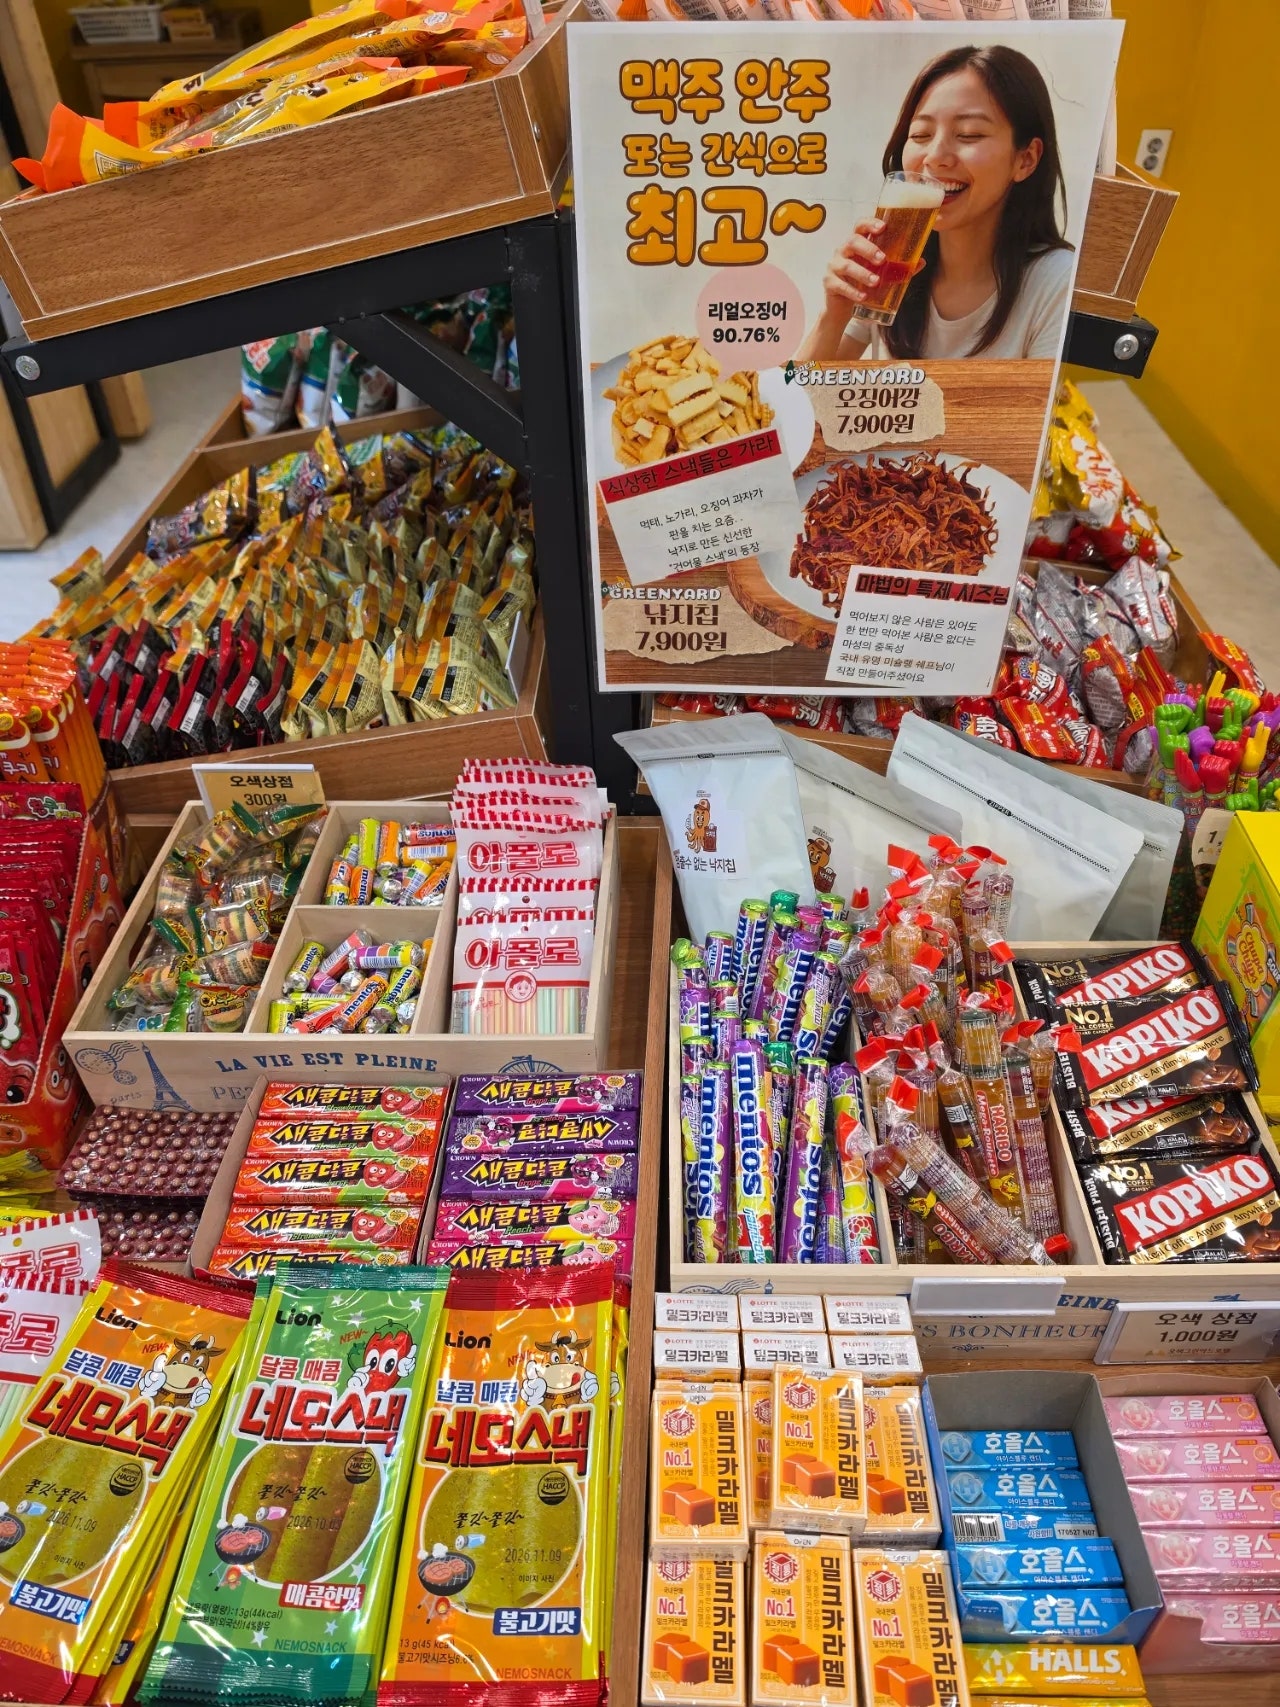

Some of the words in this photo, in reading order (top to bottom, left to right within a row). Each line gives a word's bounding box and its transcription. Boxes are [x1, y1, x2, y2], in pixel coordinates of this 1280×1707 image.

[620, 57, 724, 125] 맥주
[734, 57, 832, 124] 안주
[621, 132, 692, 179] 또는
[700, 131, 828, 176] 간식으로
[708, 301, 787, 321] 리얼오징어
[712, 327, 780, 343] 90.76%
[794, 368, 926, 386] GREENYARD
[836, 388, 922, 408] 오징어깡
[837, 413, 914, 435] 7,900원
[607, 469, 657, 497] 식상한
[665, 448, 733, 482] 스낵들은
[739, 435, 774, 456] 가라
[666, 507, 698, 523] 노가리,
[700, 497, 731, 514] 오징어
[733, 488, 763, 503] 과자가
[669, 529, 689, 540] 판을
[692, 522, 711, 534] 치는
[668, 542, 698, 557] 낙지로
[700, 535, 719, 550] 만든
[723, 527, 752, 543] 신선한
[741, 542, 760, 556] 등장
[609, 588, 721, 600] GREENYARD
[855, 573, 910, 596] 마법의
[916, 579, 954, 600] 특제
[850, 610, 889, 623] 먹어보지
[892, 615, 911, 625] 않은
[914, 618, 944, 628] 사람은
[948, 619, 977, 632] 있어도
[635, 632, 727, 652] 7,900원
[846, 625, 855, 635] 한
[859, 626, 878, 637] 번만
[881, 628, 911, 640] 먹어본
[914, 632, 944, 643] 사람은
[947, 635, 976, 646] 없다는
[842, 640, 872, 650] 마성의
[875, 643, 904, 654] 중독성
[840, 653, 858, 663] 국내
[862, 655, 881, 665] 유명
[836, 666, 855, 677] 직접
[858, 669, 925, 682] 만들어주셨어요
[229, 773, 294, 790] 오색상점
[468, 841, 580, 873] 아폴로
[694, 857, 707, 871] 없는
[300, 947, 318, 973] mentos
[465, 937, 581, 970] 아폴로
[1238, 939, 1257, 984] Chups
[1245, 931, 1264, 975] Chupa
[1043, 960, 1088, 980] No.1
[344, 981, 378, 1016] mentos
[1065, 1003, 1114, 1024] No.1
[1082, 994, 1221, 1079] KOPIKO
[215, 1058, 248, 1073] LA
[253, 1054, 294, 1068] VIE
[301, 1053, 345, 1066] EST
[356, 1052, 438, 1072] PLEINE
[290, 1087, 380, 1104] 새콤달콤
[481, 1081, 573, 1099] 새콤달콤
[276, 1125, 369, 1142] 새콤달콤
[518, 1121, 612, 1141] 새콤달콤
[736, 1053, 763, 1197] mentos
[990, 1105, 1012, 1162] HARIBO
[697, 1076, 720, 1219] mentos
[264, 1162, 359, 1183] 새콤달콤
[470, 1160, 567, 1180] 새콤달콤
[1106, 1162, 1155, 1180] No.1
[1121, 1158, 1271, 1240] KOPIKO
[250, 1212, 350, 1230] 새콤달콤
[459, 1205, 561, 1226] 새콤달콤
[505, 1225, 532, 1234] Peach
[450, 1246, 556, 1267] 새콤달콤
[95, 1307, 138, 1331] Lion
[275, 1308, 322, 1326] Lion
[666, 1310, 729, 1323] 밀크카라멜
[751, 1311, 813, 1325] 밀크카라멜
[836, 1311, 901, 1325] 밀크카라멜
[1155, 1313, 1202, 1326] 오색
[1211, 1312, 1258, 1325] 상점
[445, 1330, 492, 1350] Lion
[664, 1350, 729, 1364] 밀크카라멜
[754, 1349, 819, 1364] 밀크카라멜
[843, 1352, 909, 1366] 밀크카라멜
[65, 1348, 103, 1378] 달콤
[103, 1360, 144, 1390] 매콤
[259, 1355, 299, 1379] 달콤
[302, 1359, 341, 1383] 매콤
[437, 1380, 475, 1404] 달콤
[480, 1380, 519, 1404] 매콤
[26, 1378, 195, 1476] 네모스낵
[239, 1384, 407, 1458] 네모스낵
[786, 1422, 813, 1439] No.1
[425, 1410, 591, 1476] 네모스낵
[837, 1387, 860, 1500] 밀크카라멜
[665, 1448, 692, 1466] No.1
[895, 1404, 930, 1514] 밀크카라멜
[715, 1410, 739, 1525] 밀크카라멜
[543, 1482, 566, 1490] HACCP
[504, 1549, 562, 1564] 2026.11.09
[518, 1574, 539, 1583] 이미지
[540, 1574, 555, 1583] 사진
[18, 1582, 87, 1623] 불고기맛
[285, 1583, 362, 1613] 매콤한맛
[658, 1596, 687, 1616] No.1
[766, 1598, 794, 1617] No.1
[499, 1611, 577, 1634] 불고기맛
[820, 1556, 846, 1688] 밀크카라멜
[872, 1619, 903, 1638] No.1
[275, 1639, 348, 1653] NEMOSNACK
[1030, 1648, 1122, 1674] HALLS
[496, 1668, 573, 1680] NEMOSNACK
